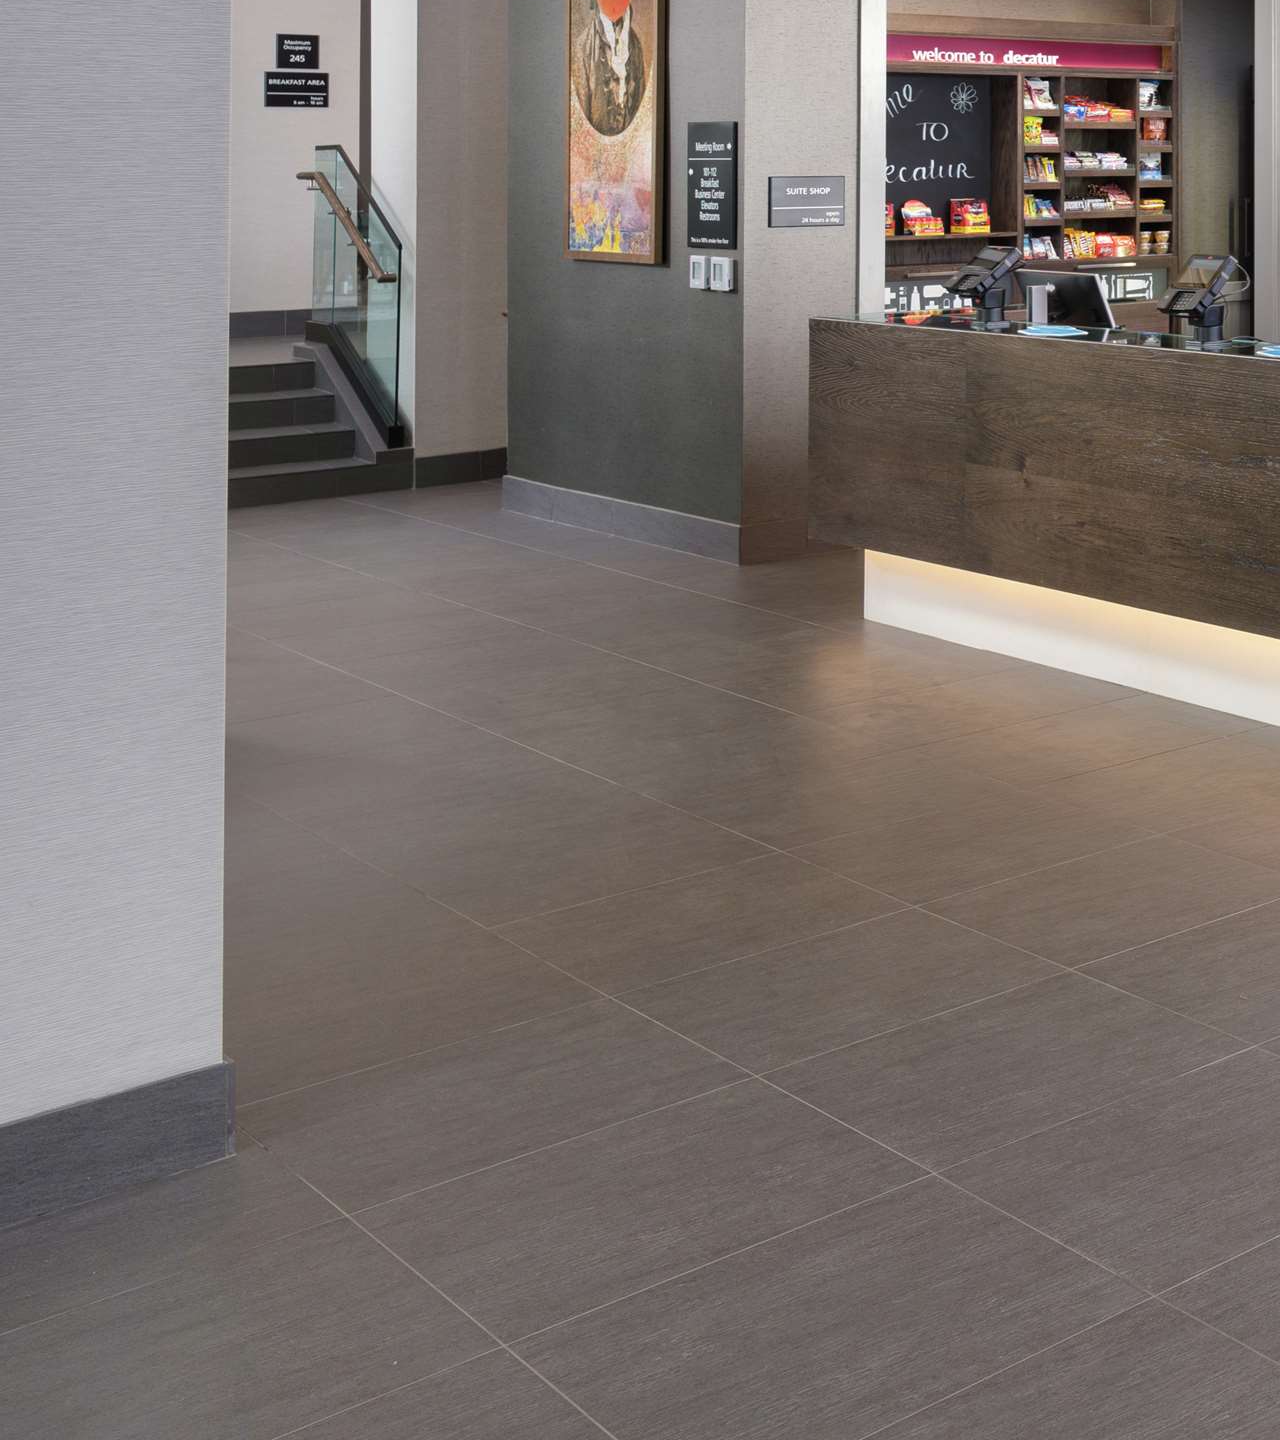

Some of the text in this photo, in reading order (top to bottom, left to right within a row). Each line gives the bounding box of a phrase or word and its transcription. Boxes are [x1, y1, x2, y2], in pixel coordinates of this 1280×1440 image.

[289, 54, 306, 62] 245
[912, 48, 1058, 65] welcome to decatur
[916, 122, 949, 141] TO
[695, 142, 725, 154] Meeting Room
[810, 187, 831, 195] SHOP
